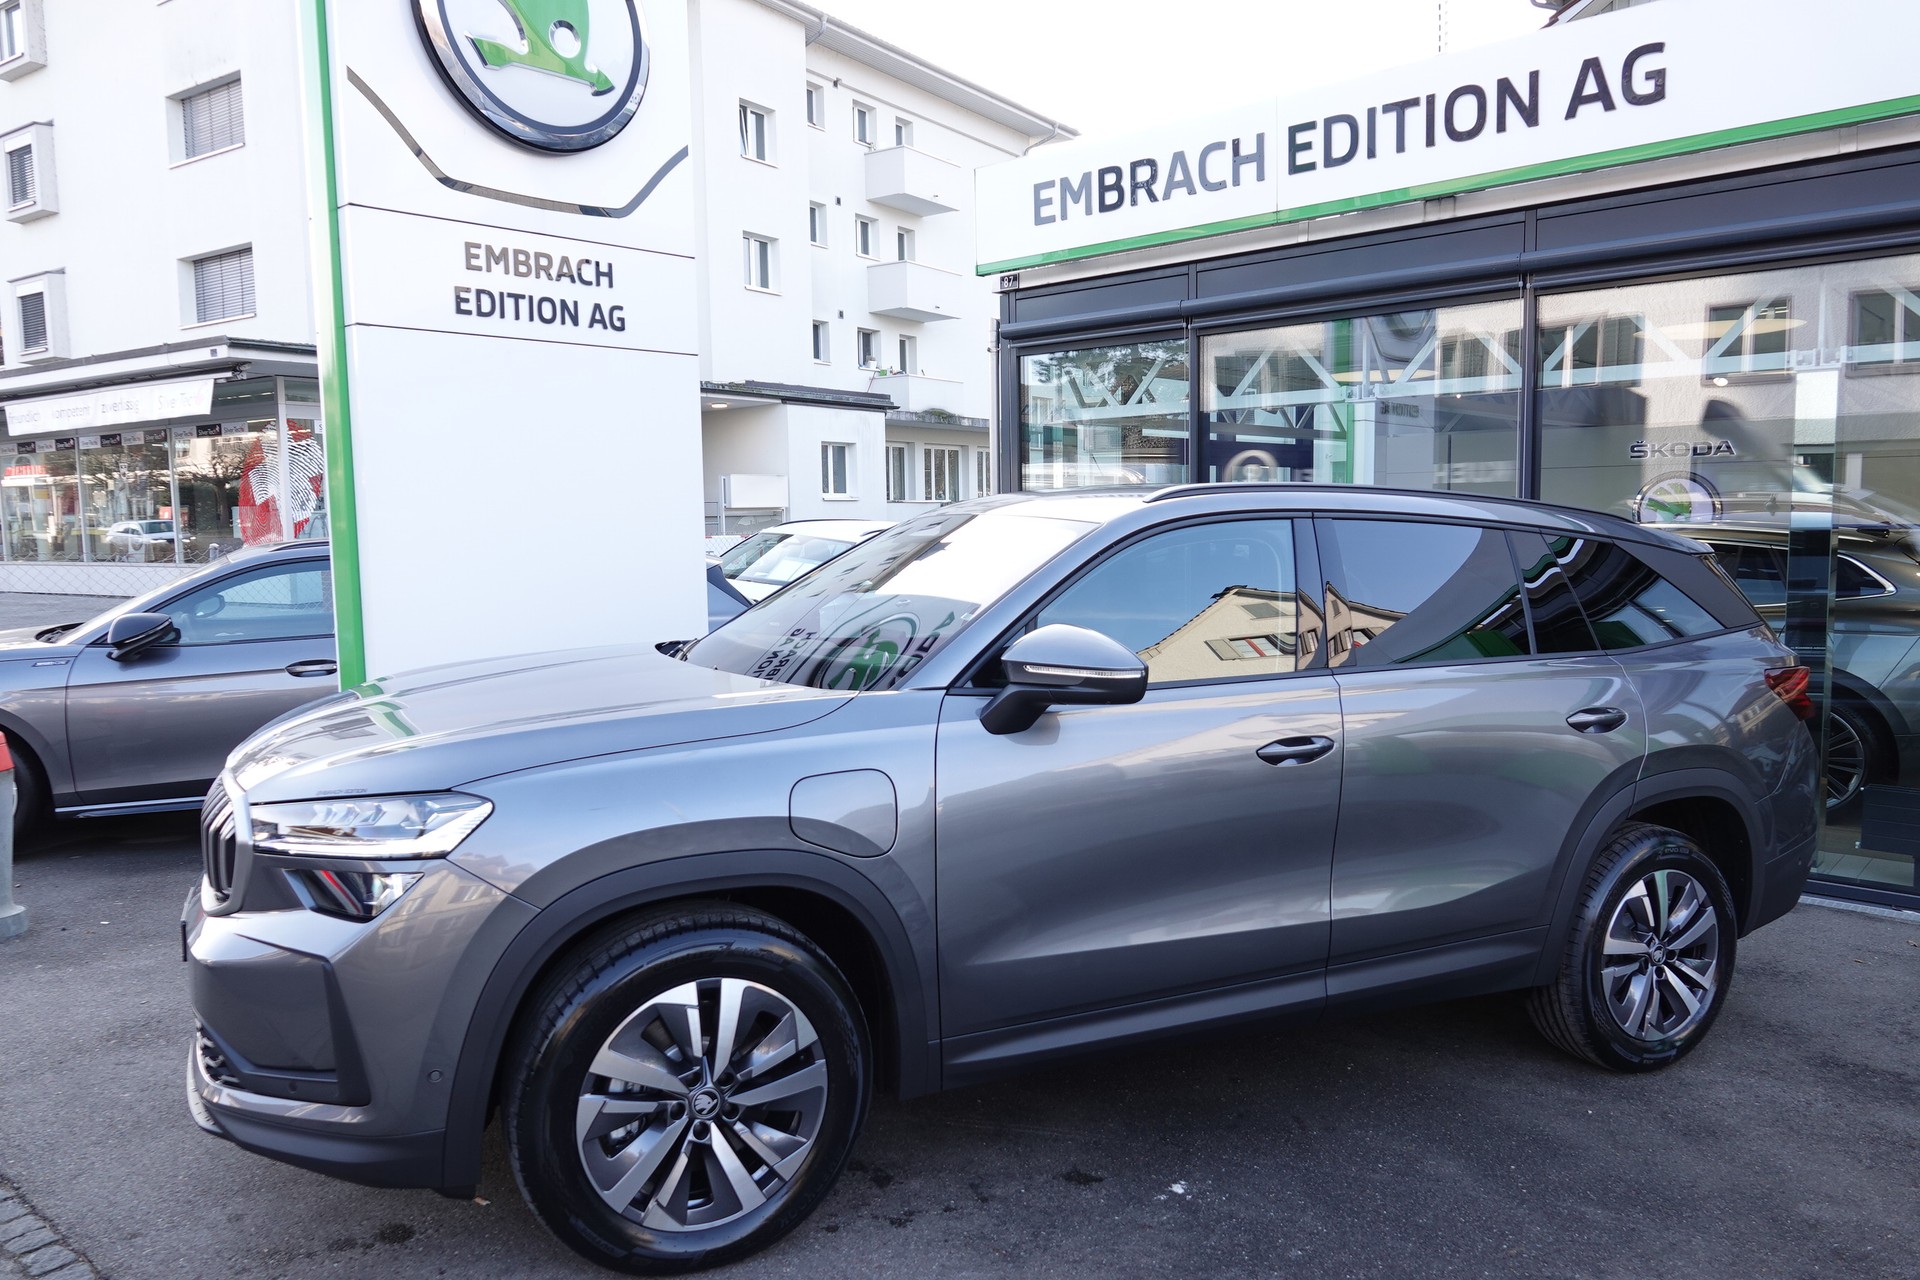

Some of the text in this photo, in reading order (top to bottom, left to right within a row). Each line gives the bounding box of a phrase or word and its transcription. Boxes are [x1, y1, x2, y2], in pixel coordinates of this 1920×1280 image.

[1033, 41, 1668, 227] EMBRACH EDITION AG
[464, 241, 614, 289] EMBRACH
[454, 285, 626, 332] EDITION AG
[1630, 440, 1737, 459] ŠKODA
